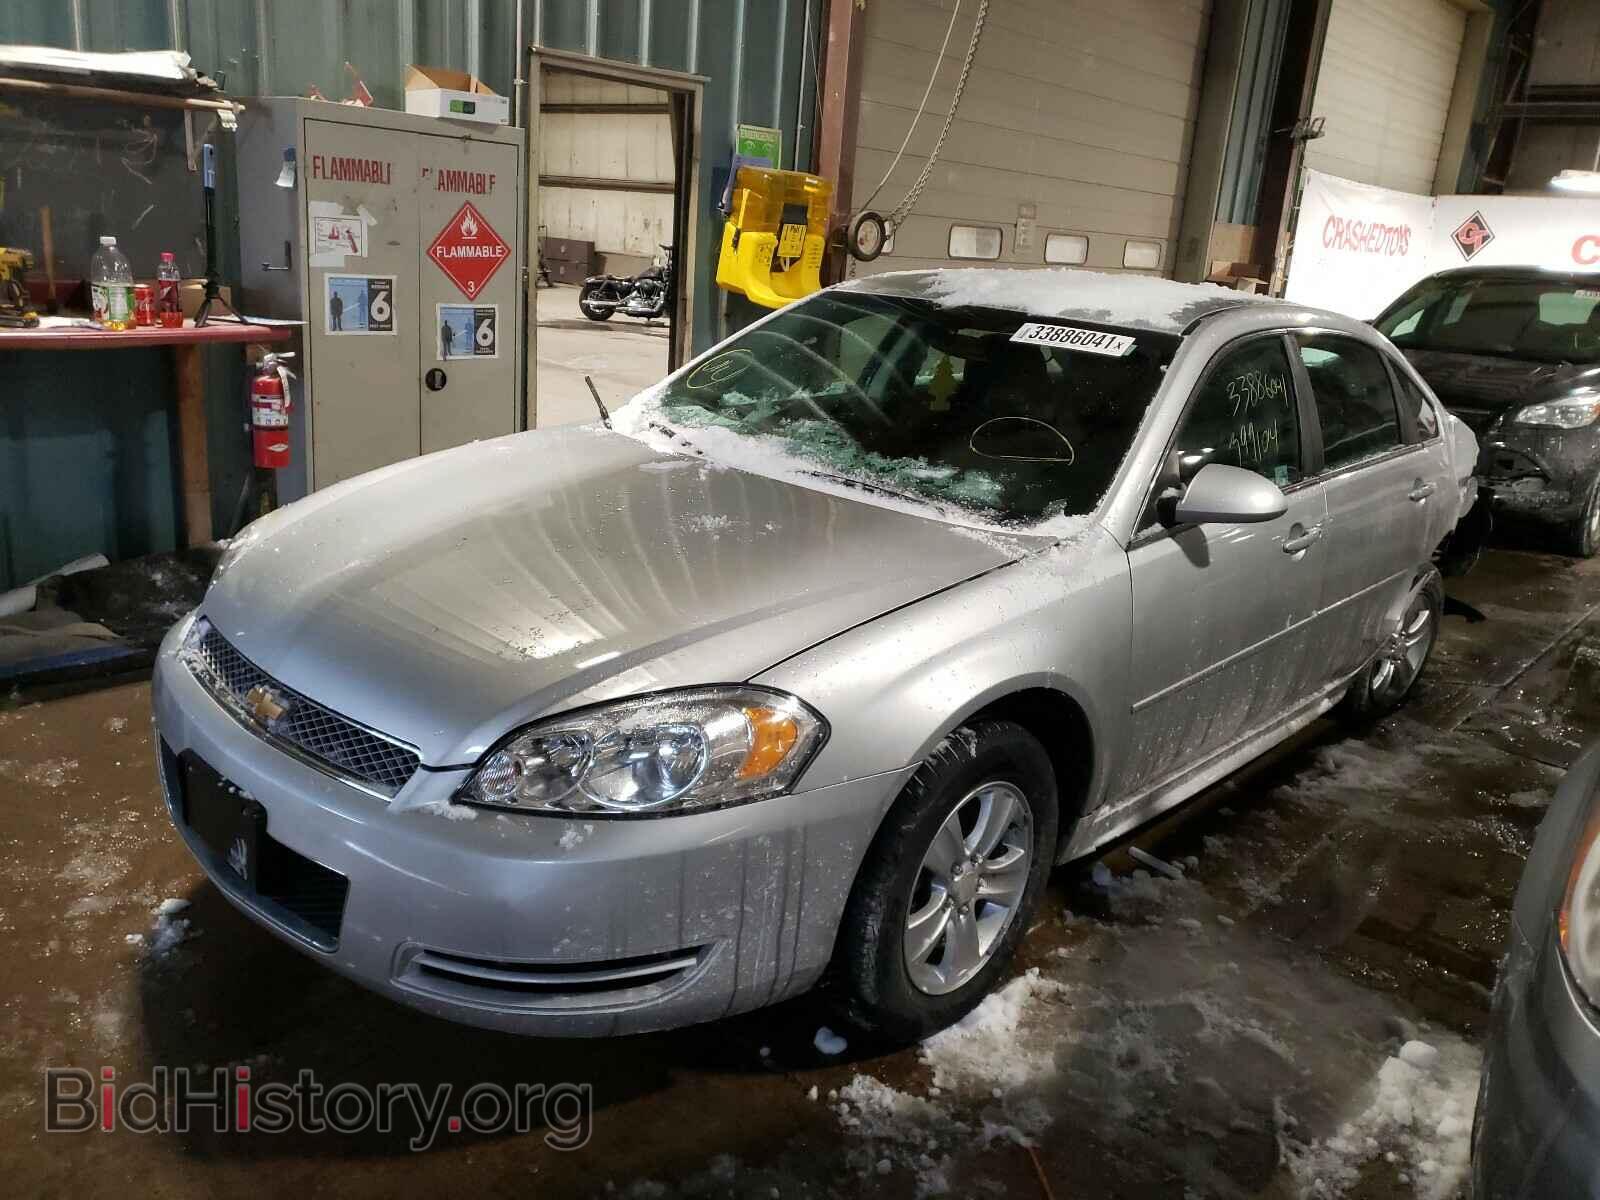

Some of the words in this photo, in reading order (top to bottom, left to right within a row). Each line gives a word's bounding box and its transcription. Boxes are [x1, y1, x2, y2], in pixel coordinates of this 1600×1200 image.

[437, 246, 503, 258] FLAMMABLE
[467, 281, 475, 293] 3
[371, 291, 391, 321] 6
[476, 318, 494, 347] 6
[1029, 325, 1116, 349] 33886041
